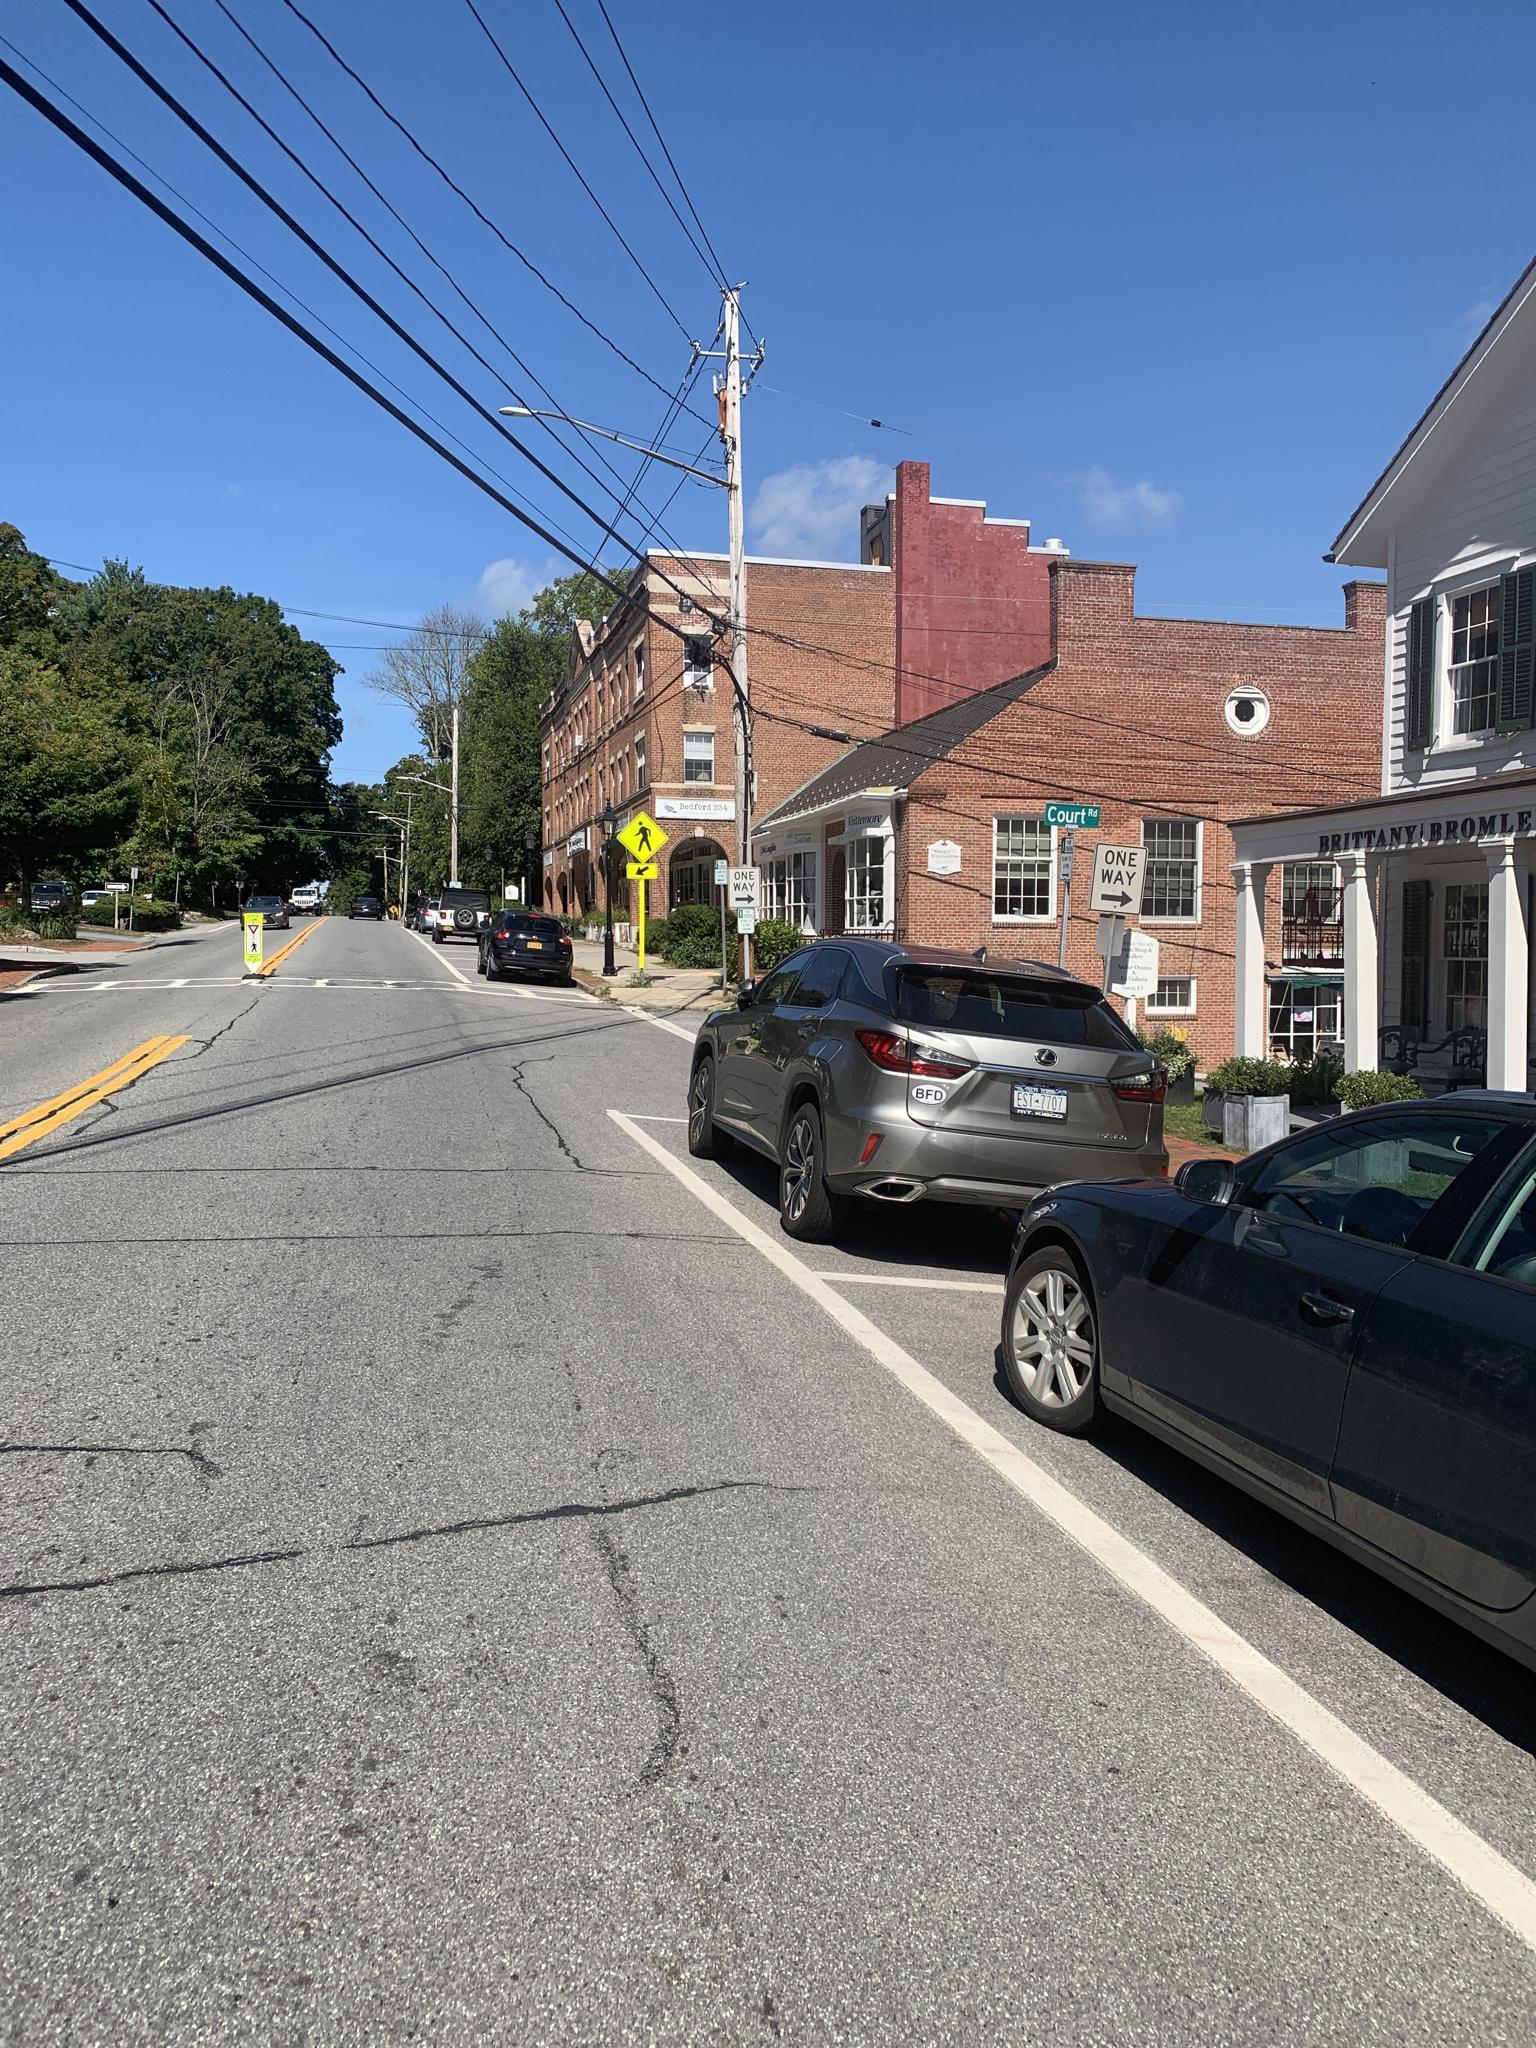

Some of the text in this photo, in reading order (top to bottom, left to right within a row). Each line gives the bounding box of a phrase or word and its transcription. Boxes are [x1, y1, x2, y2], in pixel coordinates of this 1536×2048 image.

[679, 802, 712, 811] Bedford
[1047, 805, 1098, 825] Court Rd
[1318, 810, 1536, 852] BRITTANY BROMLE
[1104, 850, 1138, 868] ONE
[734, 871, 755, 881] ONE
[1101, 869, 1137, 886] WAY
[733, 882, 755, 892] WAY
[915, 1088, 943, 1101] BFD
